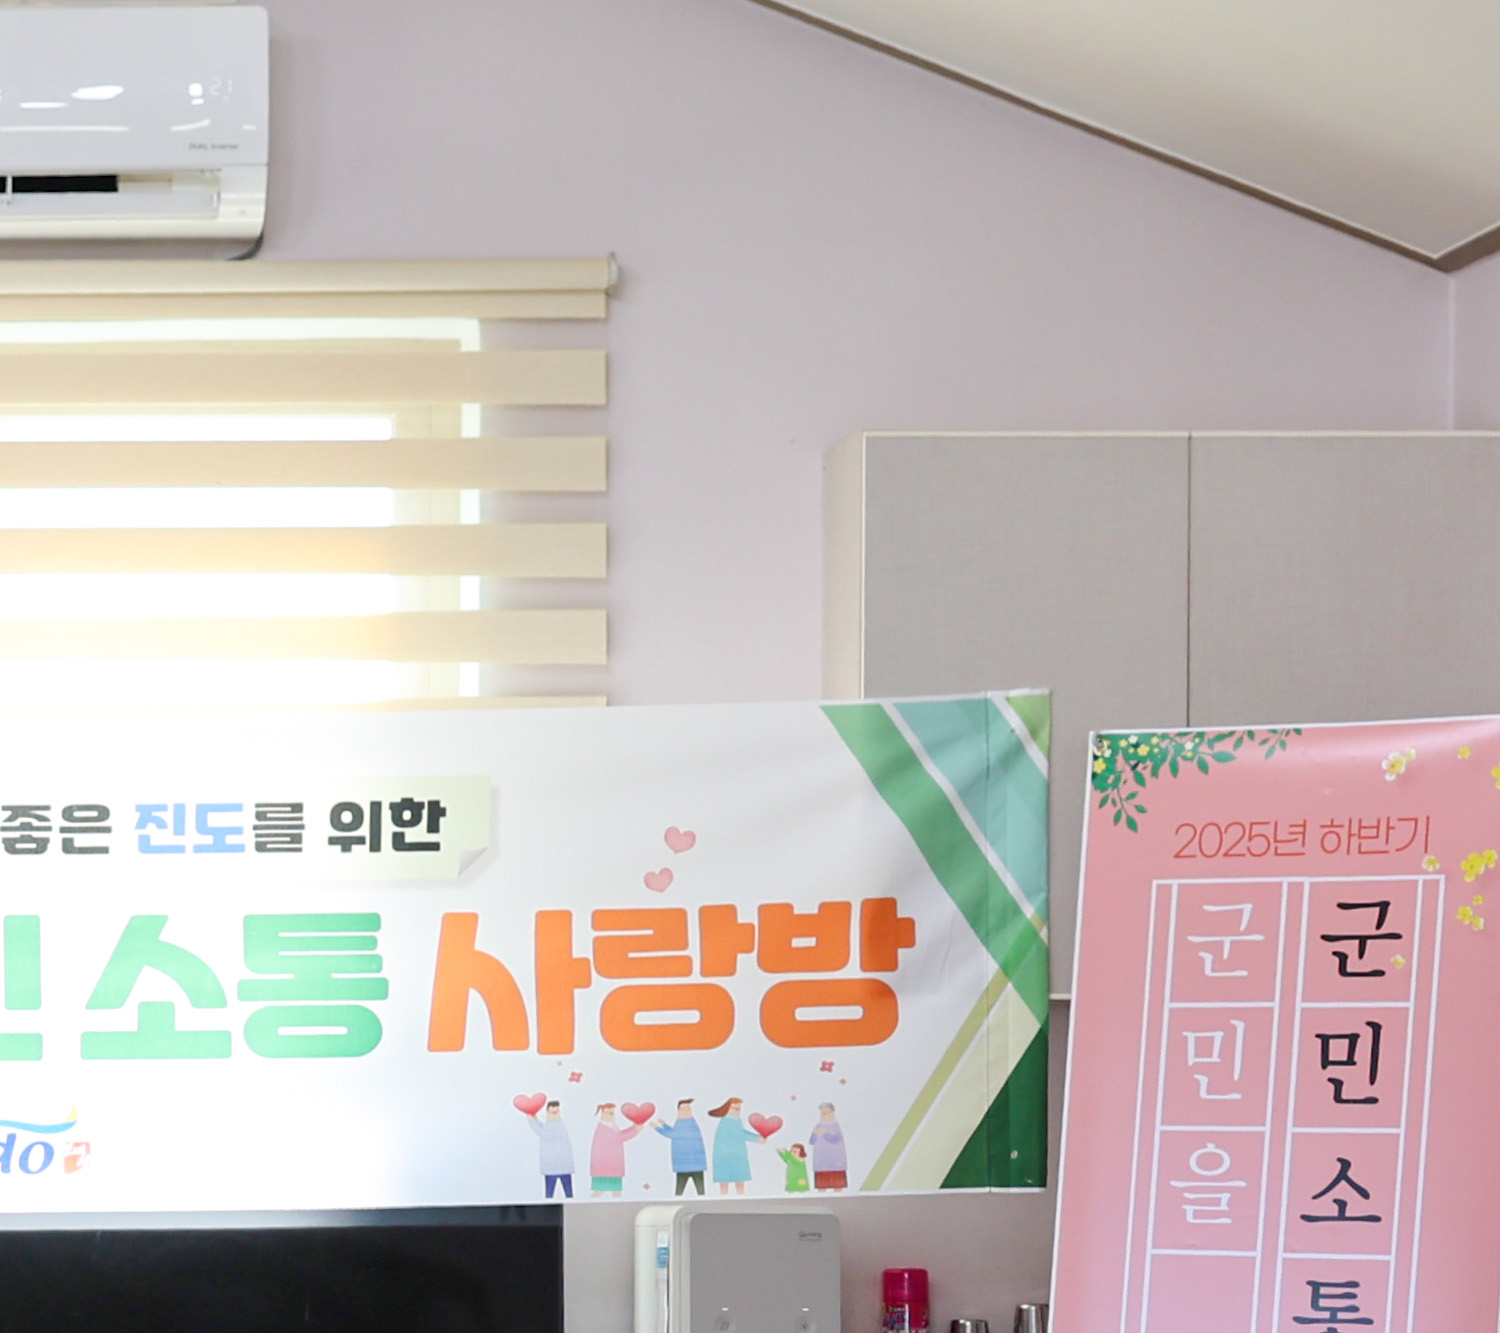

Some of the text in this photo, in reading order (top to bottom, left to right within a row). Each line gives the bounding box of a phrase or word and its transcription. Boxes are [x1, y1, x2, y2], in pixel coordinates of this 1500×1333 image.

[134, 801, 306, 855] 진도를
[327, 797, 448, 854] 위한
[1173, 814, 1431, 860] 2025년 하반기
[79, 911, 390, 1061] 소통
[426, 896, 917, 1056] 사랑방
